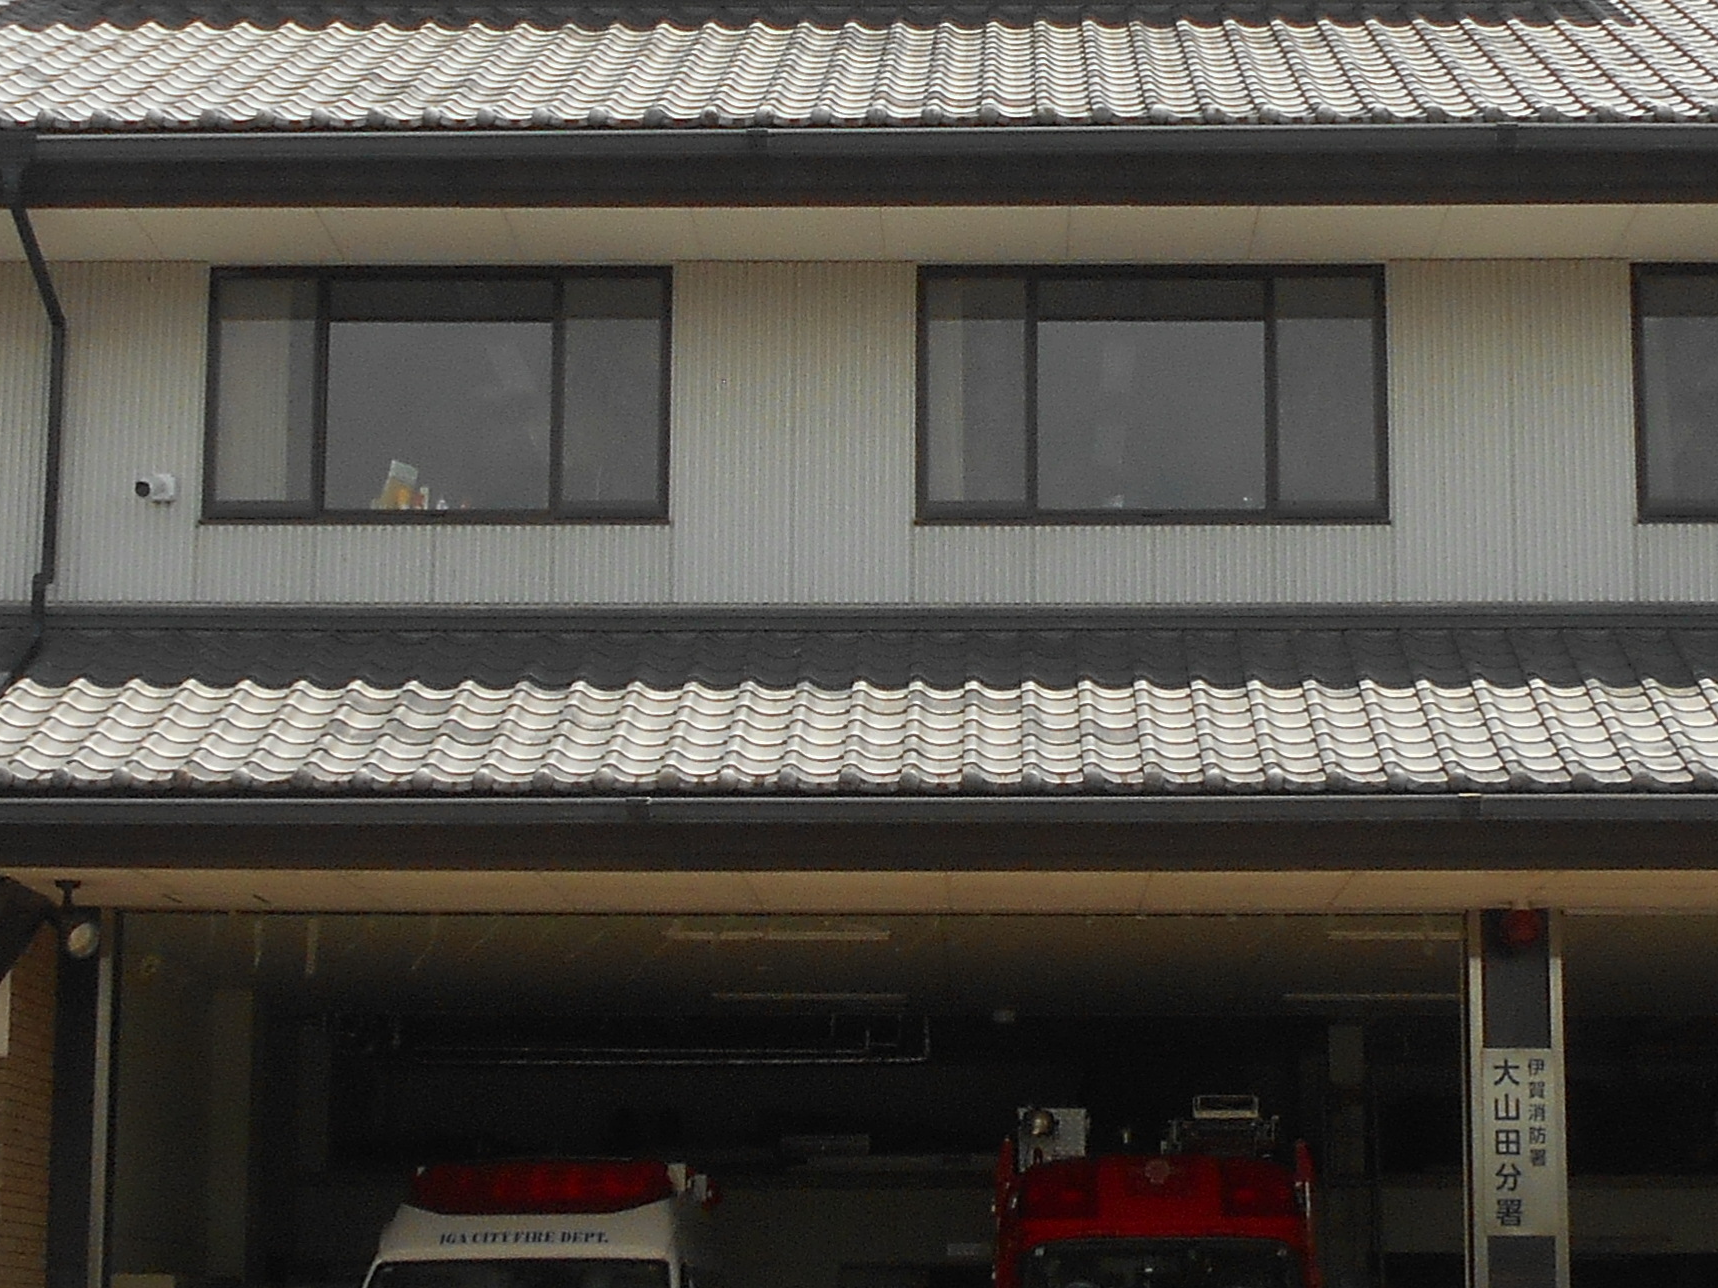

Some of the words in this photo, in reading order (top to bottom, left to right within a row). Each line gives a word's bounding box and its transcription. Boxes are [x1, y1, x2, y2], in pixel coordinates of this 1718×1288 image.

[1493, 1059, 1522, 1227] 大山田分署
[1528, 1058, 1546, 1166] 伊賀消防署
[472, 1231, 512, 1244] CITY
[513, 1230, 557, 1244] FIRE
[560, 1230, 610, 1244] DEPT.
